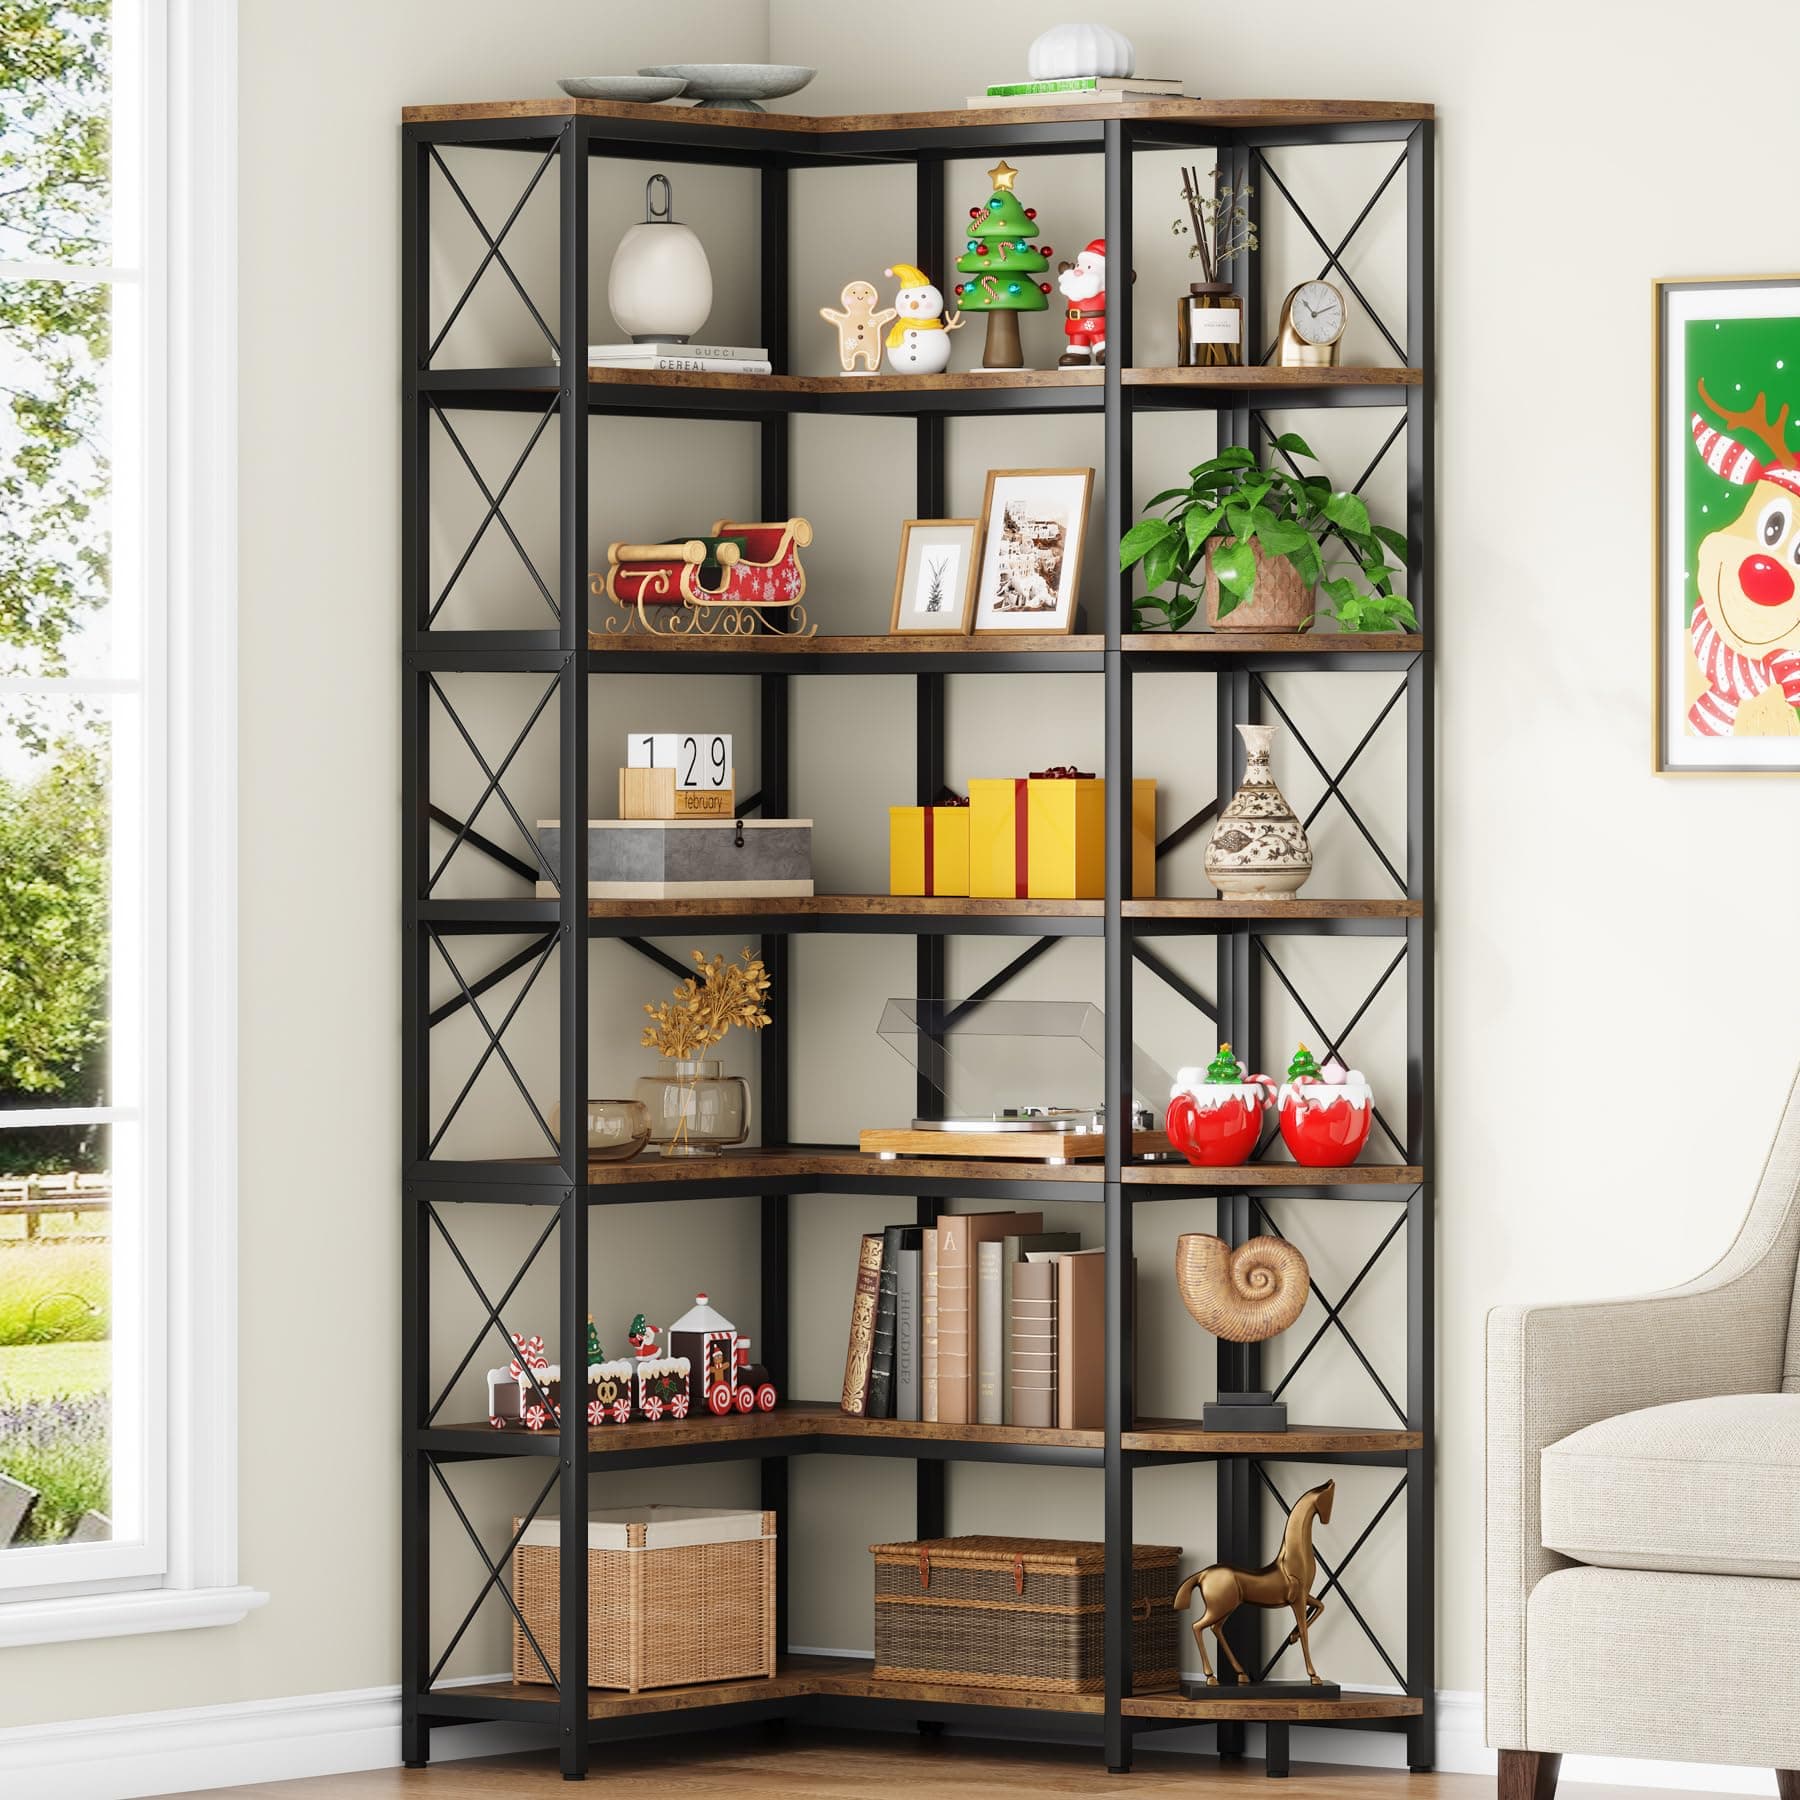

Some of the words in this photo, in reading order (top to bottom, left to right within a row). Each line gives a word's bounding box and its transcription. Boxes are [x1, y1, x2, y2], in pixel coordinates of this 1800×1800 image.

[695, 347, 735, 357] GUCCI
[659, 359, 706, 372] CEREAL
[642, 736, 654, 768] 1
[684, 792, 722, 813] february
[944, 1231, 957, 1250] A
